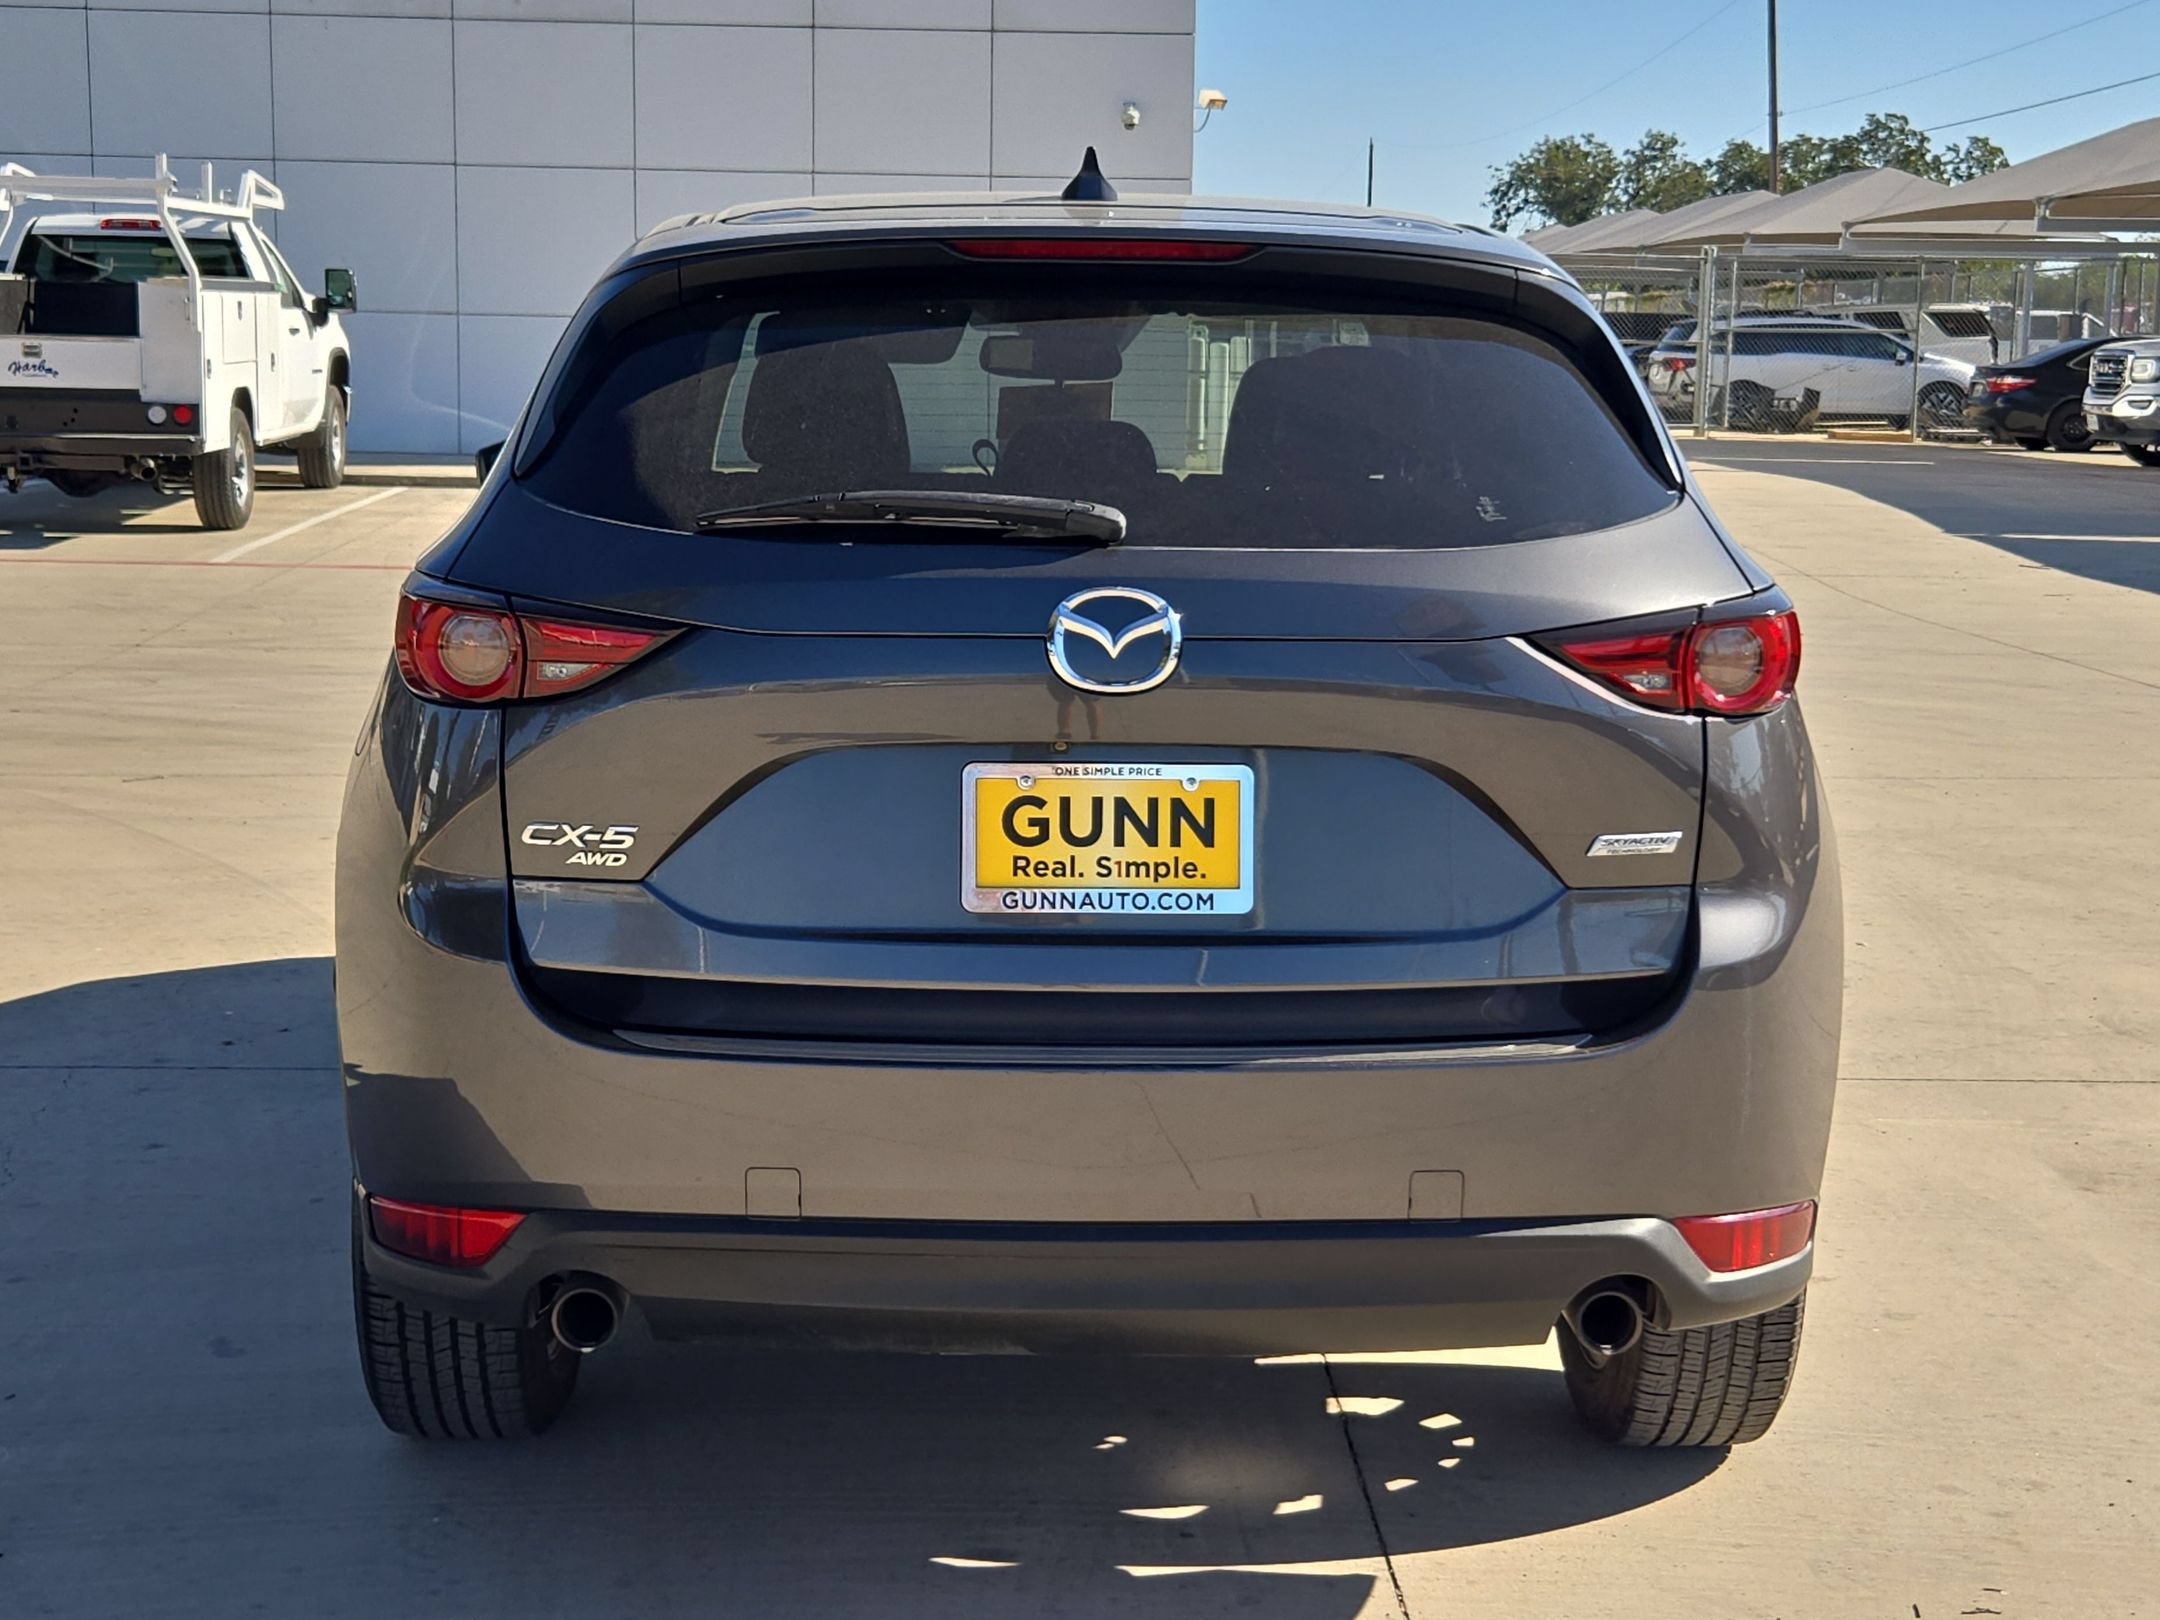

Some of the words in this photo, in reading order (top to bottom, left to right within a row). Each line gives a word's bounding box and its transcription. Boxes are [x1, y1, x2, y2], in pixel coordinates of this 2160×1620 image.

[1055, 767, 1080, 776] ONE
[1082, 767, 1125, 776] SIMPLE
[1128, 767, 1162, 776] PRICE
[1001, 795, 1215, 848] GUNN
[521, 822, 639, 849] CX-5
[565, 851, 628, 867] AWD
[1012, 855, 1084, 878] Real.
[1002, 891, 1214, 911] GUNNAUTO.COM
